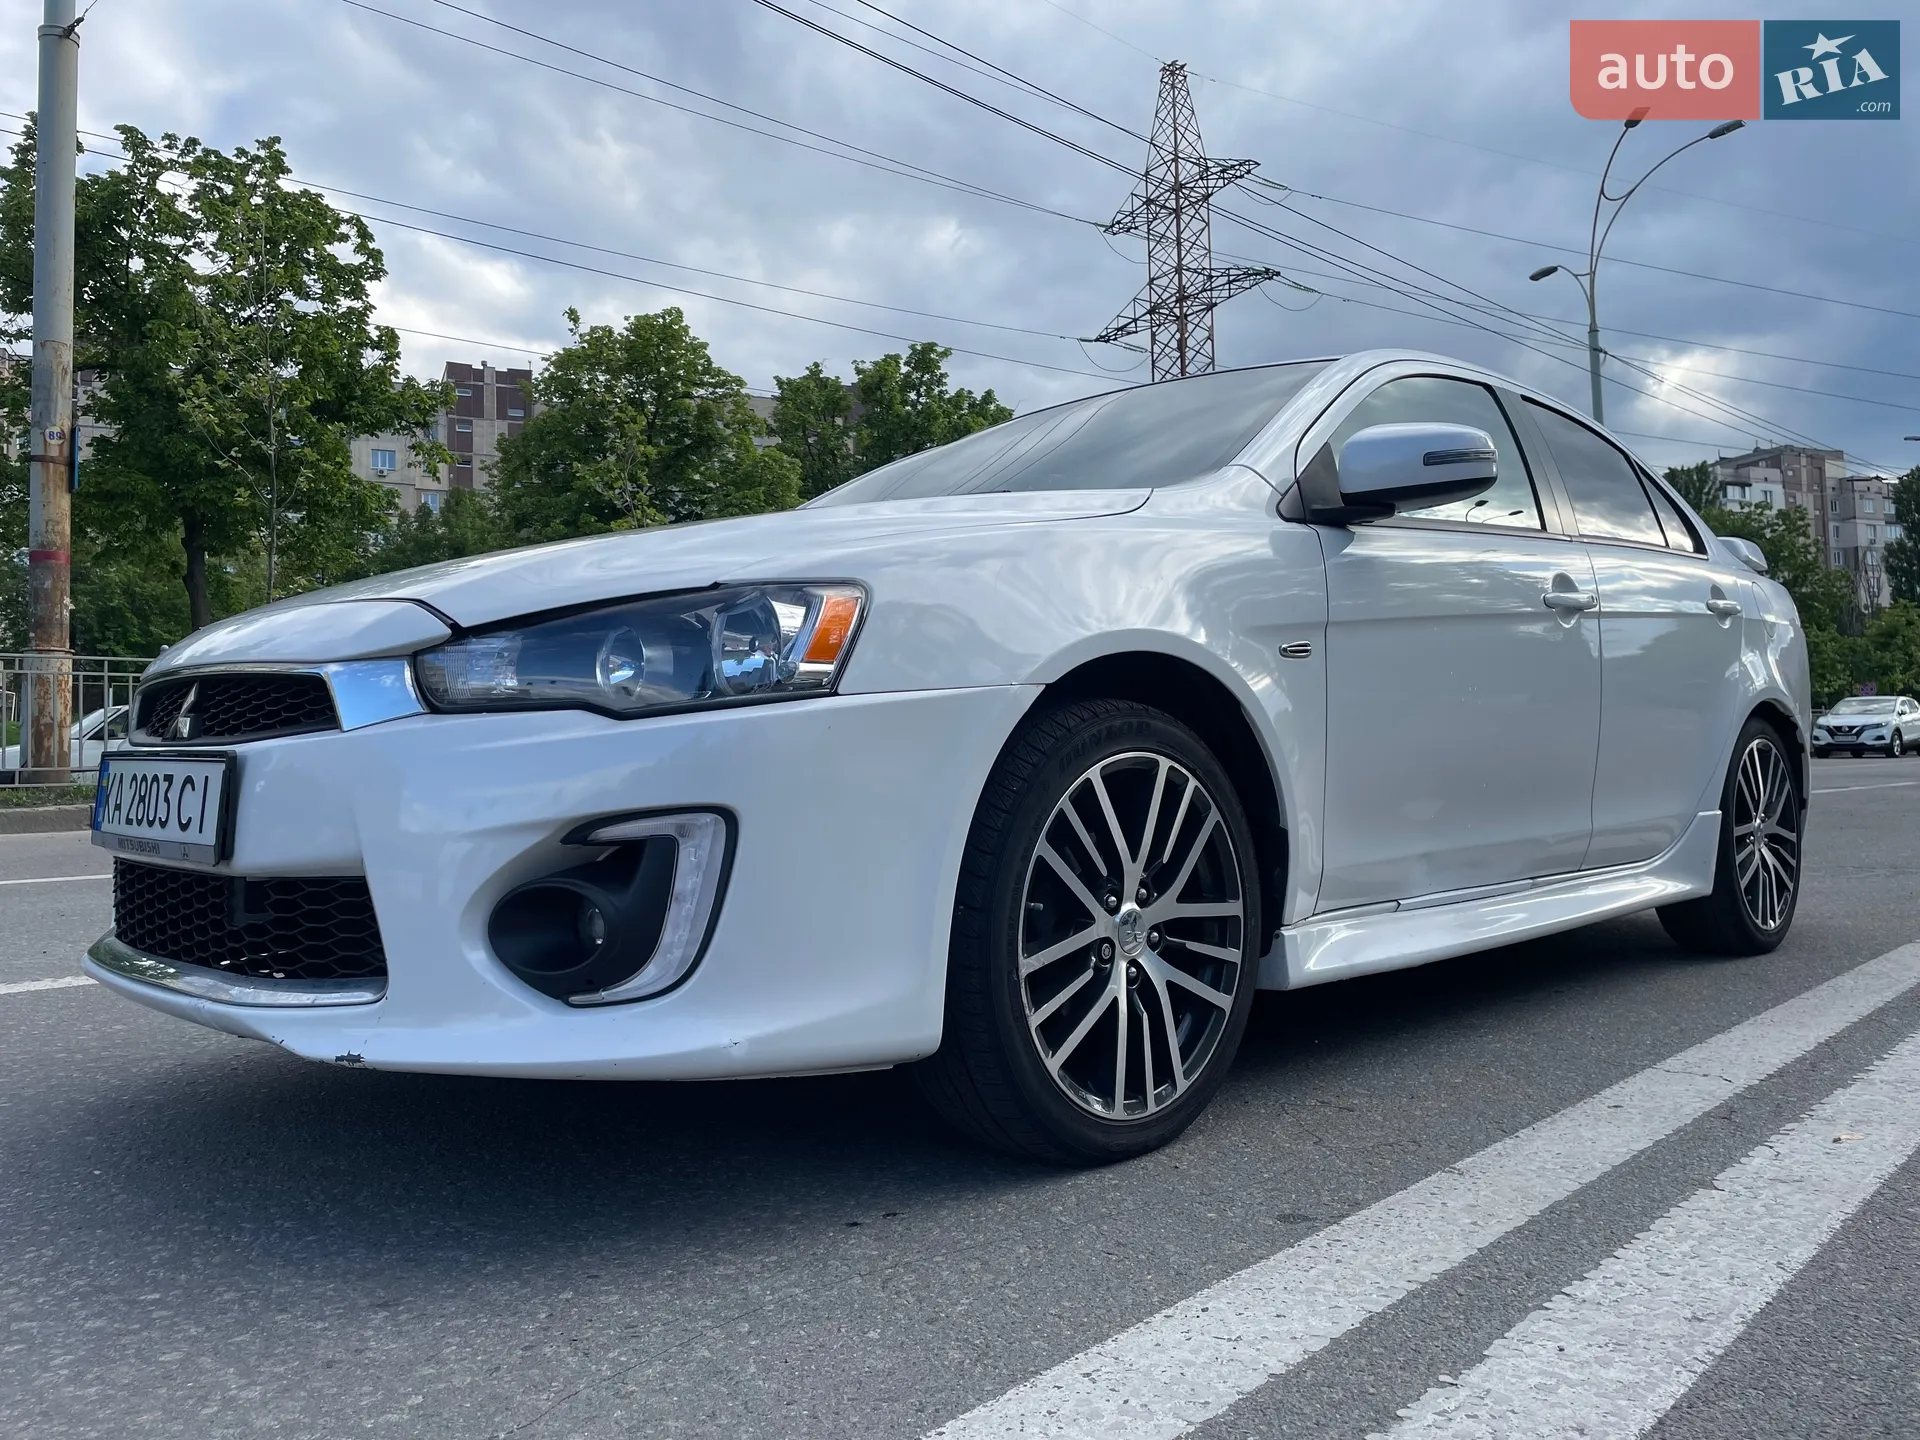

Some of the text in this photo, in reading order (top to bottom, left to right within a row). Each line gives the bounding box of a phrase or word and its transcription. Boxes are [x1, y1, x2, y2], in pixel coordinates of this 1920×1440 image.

[102, 772, 209, 835] KA 2803 CI
[117, 837, 161, 855] MITSUBISHI
